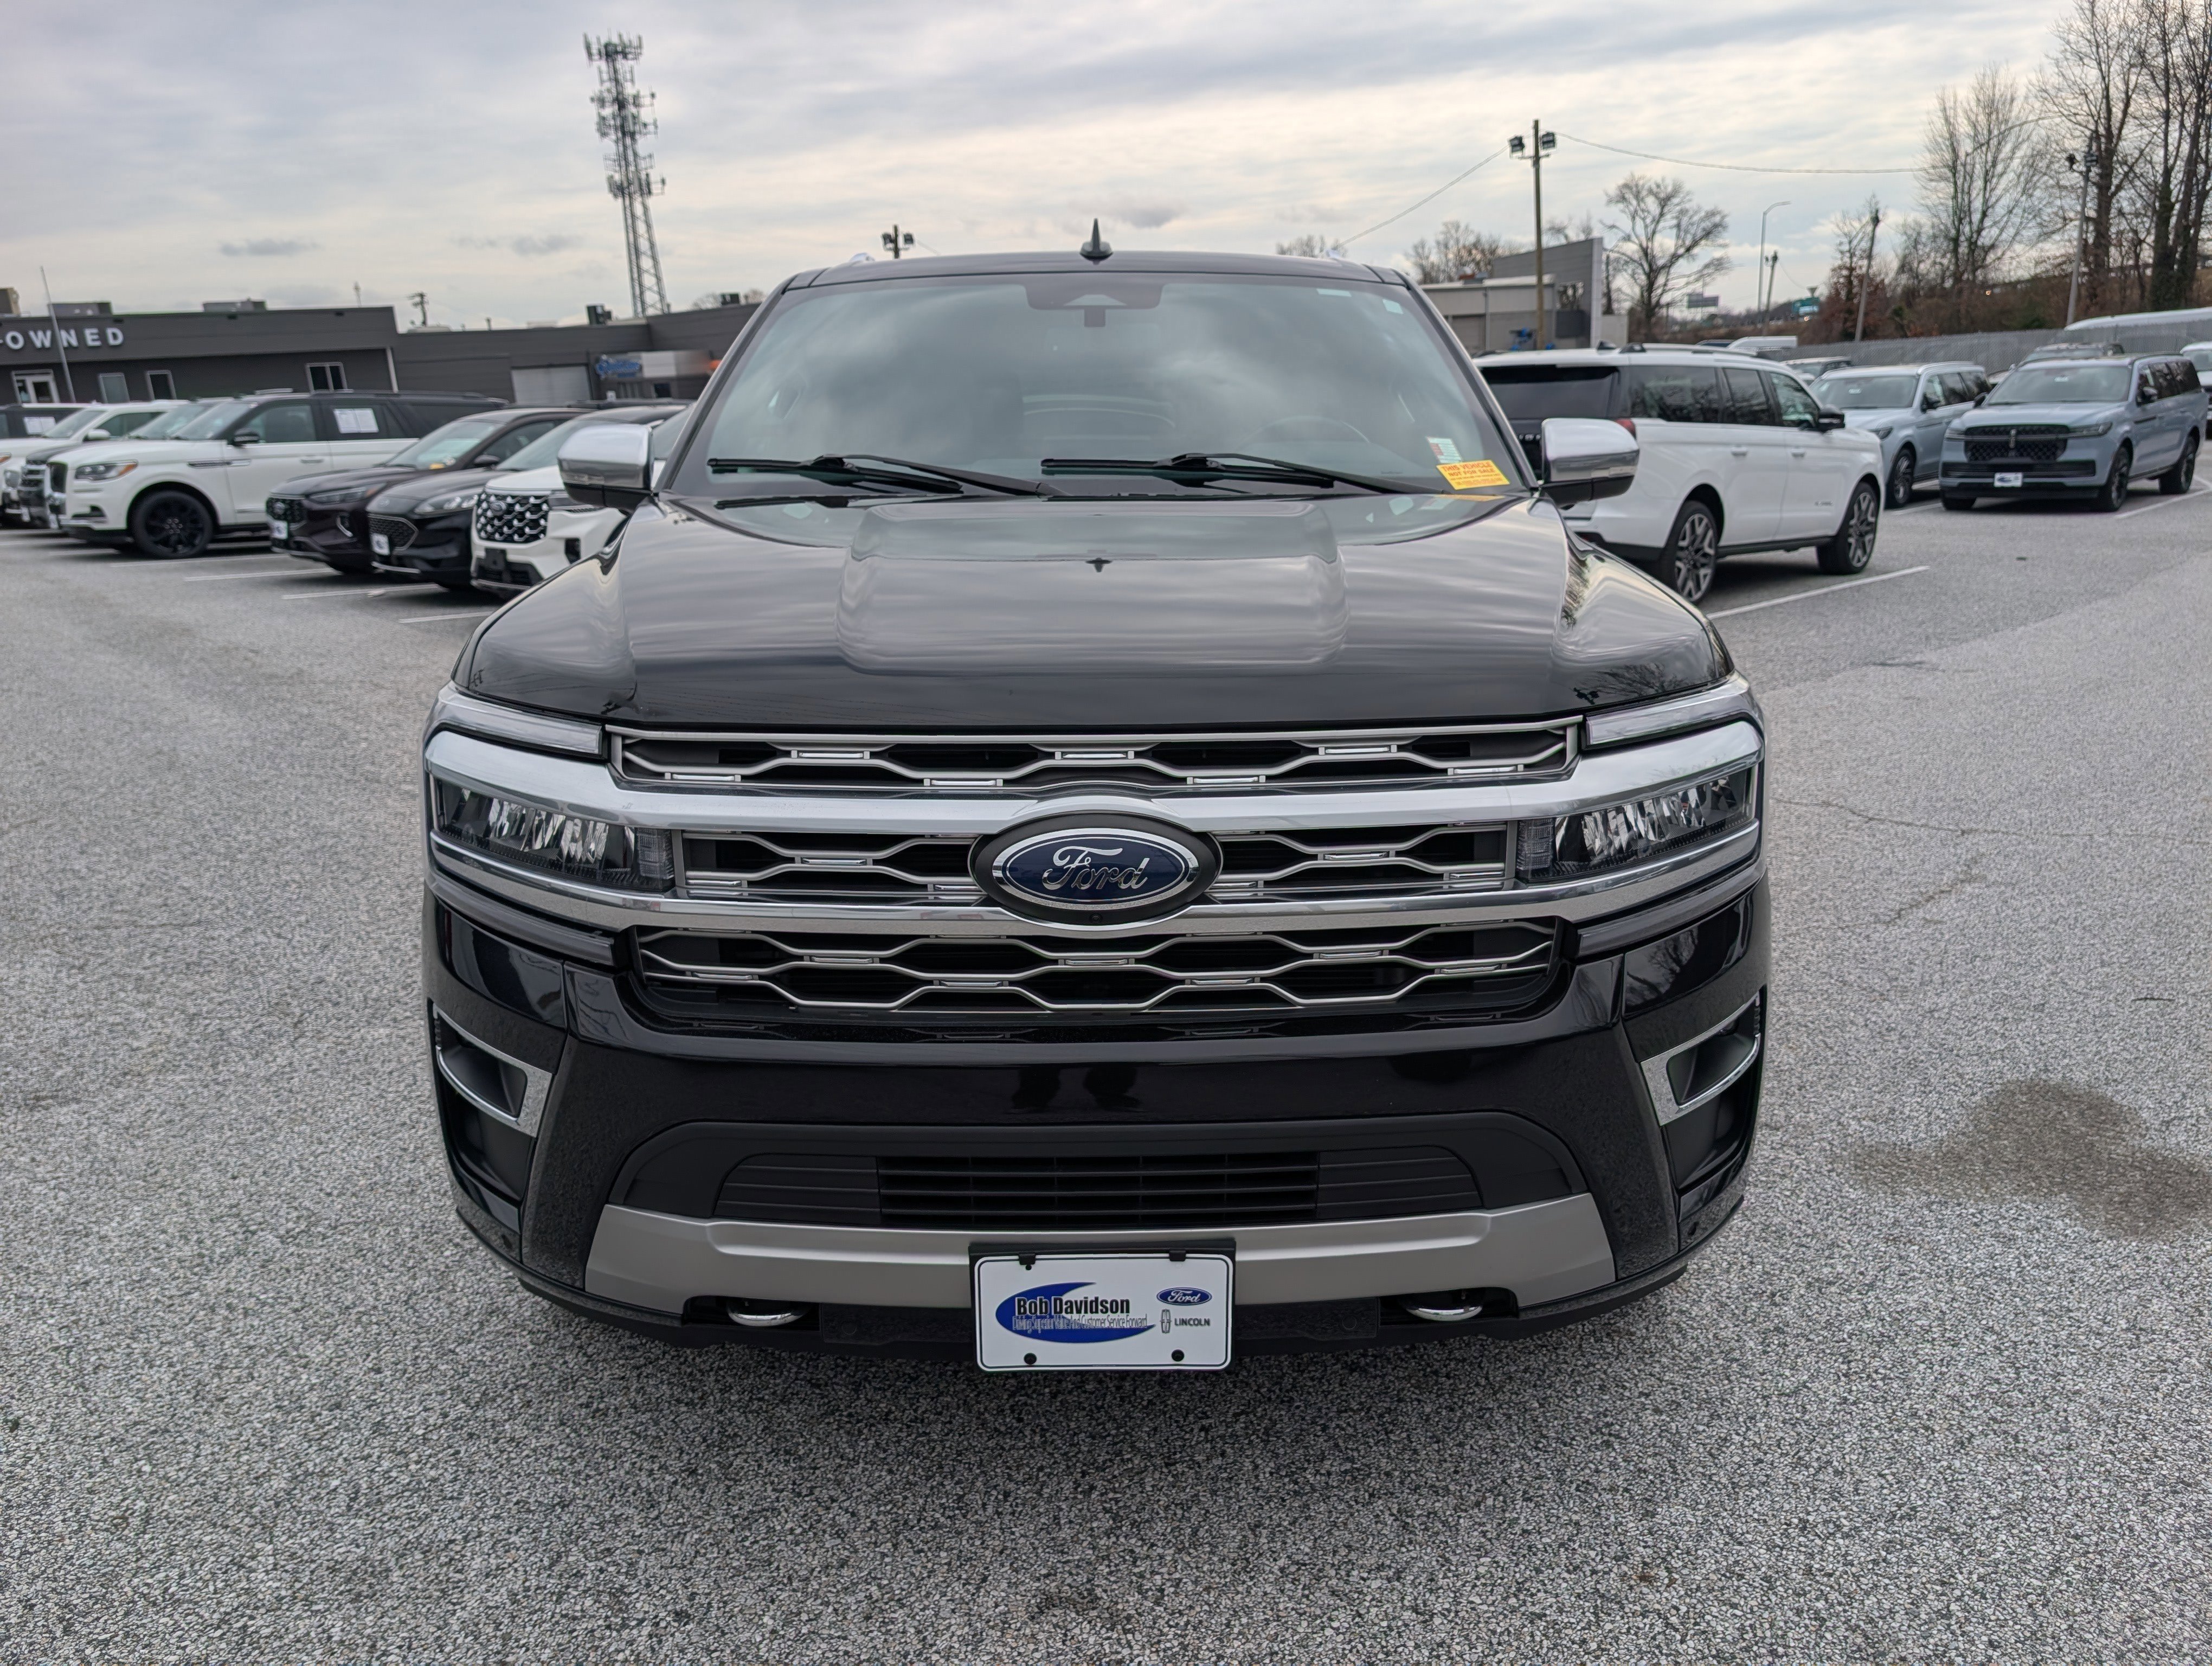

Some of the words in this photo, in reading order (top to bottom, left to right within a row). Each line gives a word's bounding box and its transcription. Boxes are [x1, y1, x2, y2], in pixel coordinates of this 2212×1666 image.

[1461, 461, 1493, 470] VEHICLE
[1042, 845, 1150, 890] Ford
[1167, 1290, 1201, 1303] Ford
[1016, 1297, 1050, 1315] Bob
[1052, 1297, 1130, 1315] Davidson
[1126, 1313, 1148, 1328] Forward
[1174, 1318, 1211, 1327] LINCOLN
